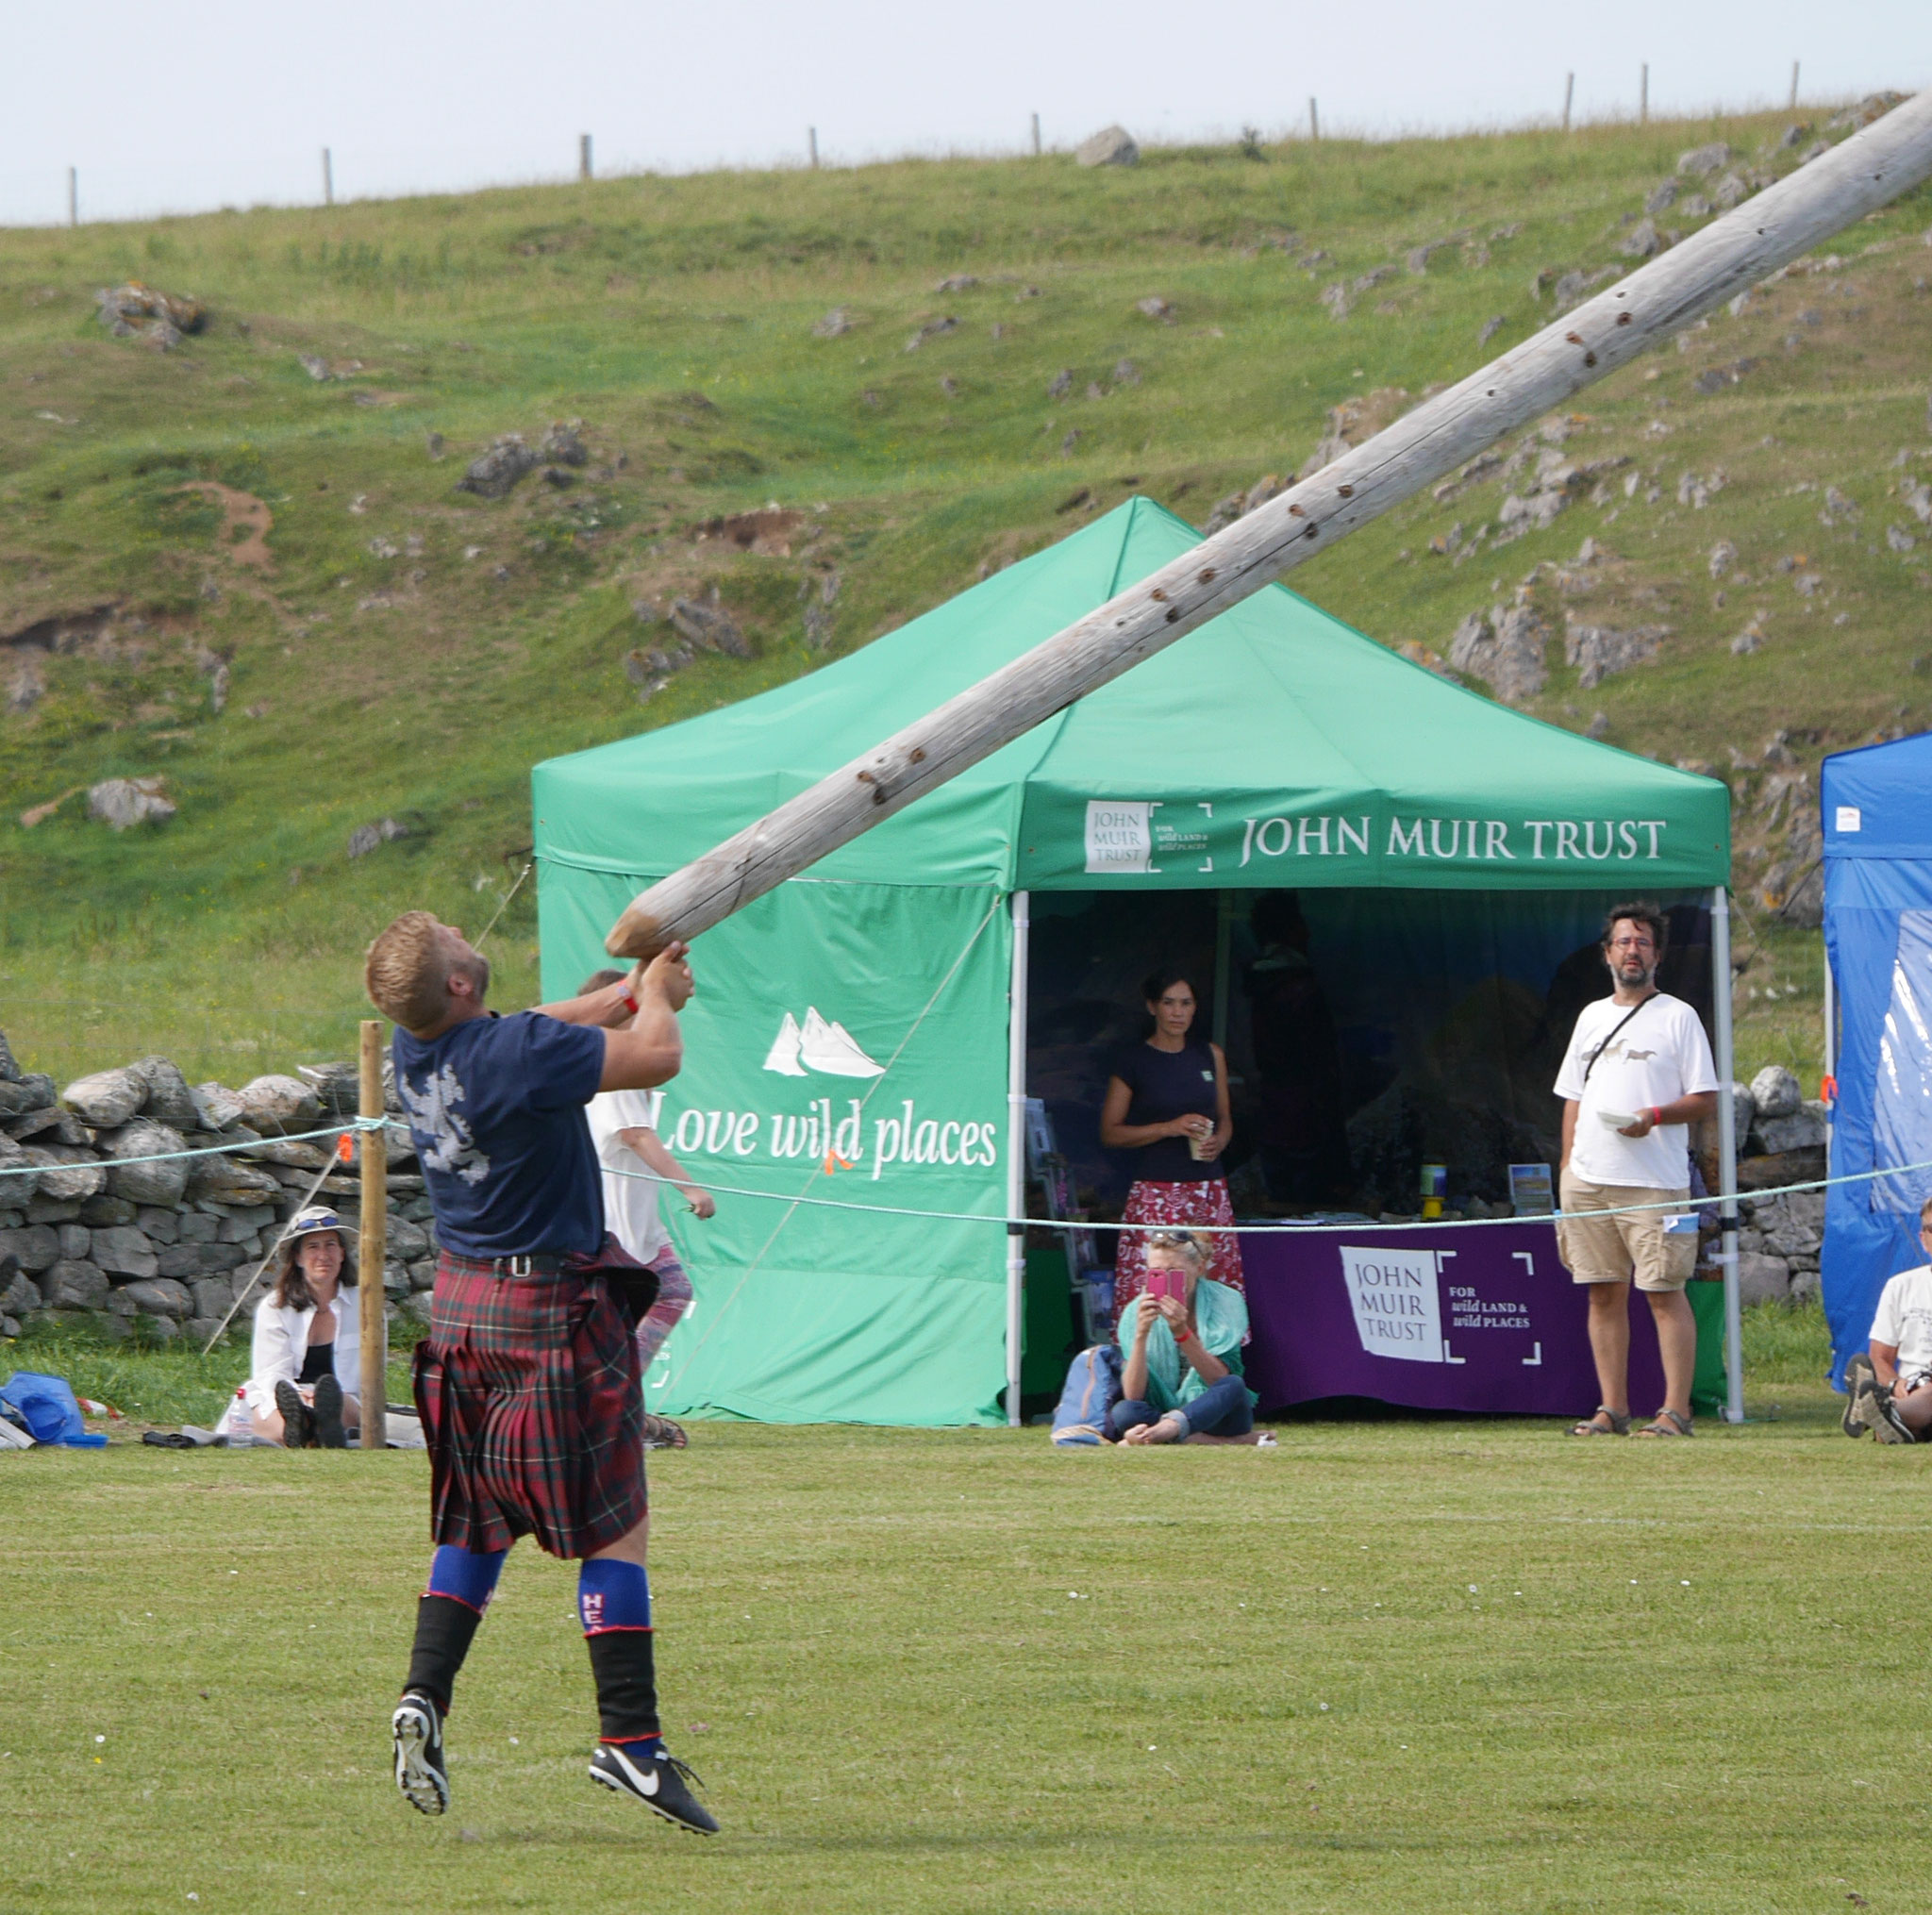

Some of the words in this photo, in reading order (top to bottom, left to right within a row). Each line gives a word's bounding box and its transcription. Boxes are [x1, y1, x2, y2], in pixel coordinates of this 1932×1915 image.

[1094, 812, 1140, 829] JOHN
[1094, 831, 1141, 845] MUIR
[1239, 816, 1372, 868] JOHN
[1386, 817, 1515, 859] MUIR
[1524, 820, 1668, 860] TRUST
[1095, 849, 1141, 861] TRUST
[771, 1098, 863, 1160] wild
[872, 1099, 997, 1180] places
[1356, 1264, 1423, 1288] JOHN
[1449, 1287, 1476, 1297] FOR
[1361, 1292, 1426, 1316] MUIR
[1452, 1300, 1480, 1312] wild
[1482, 1303, 1517, 1312] LAND
[1519, 1304, 1528, 1312] &
[1363, 1318, 1426, 1341] TRUST
[1453, 1315, 1481, 1327] wild
[1483, 1317, 1530, 1328] PLACES
